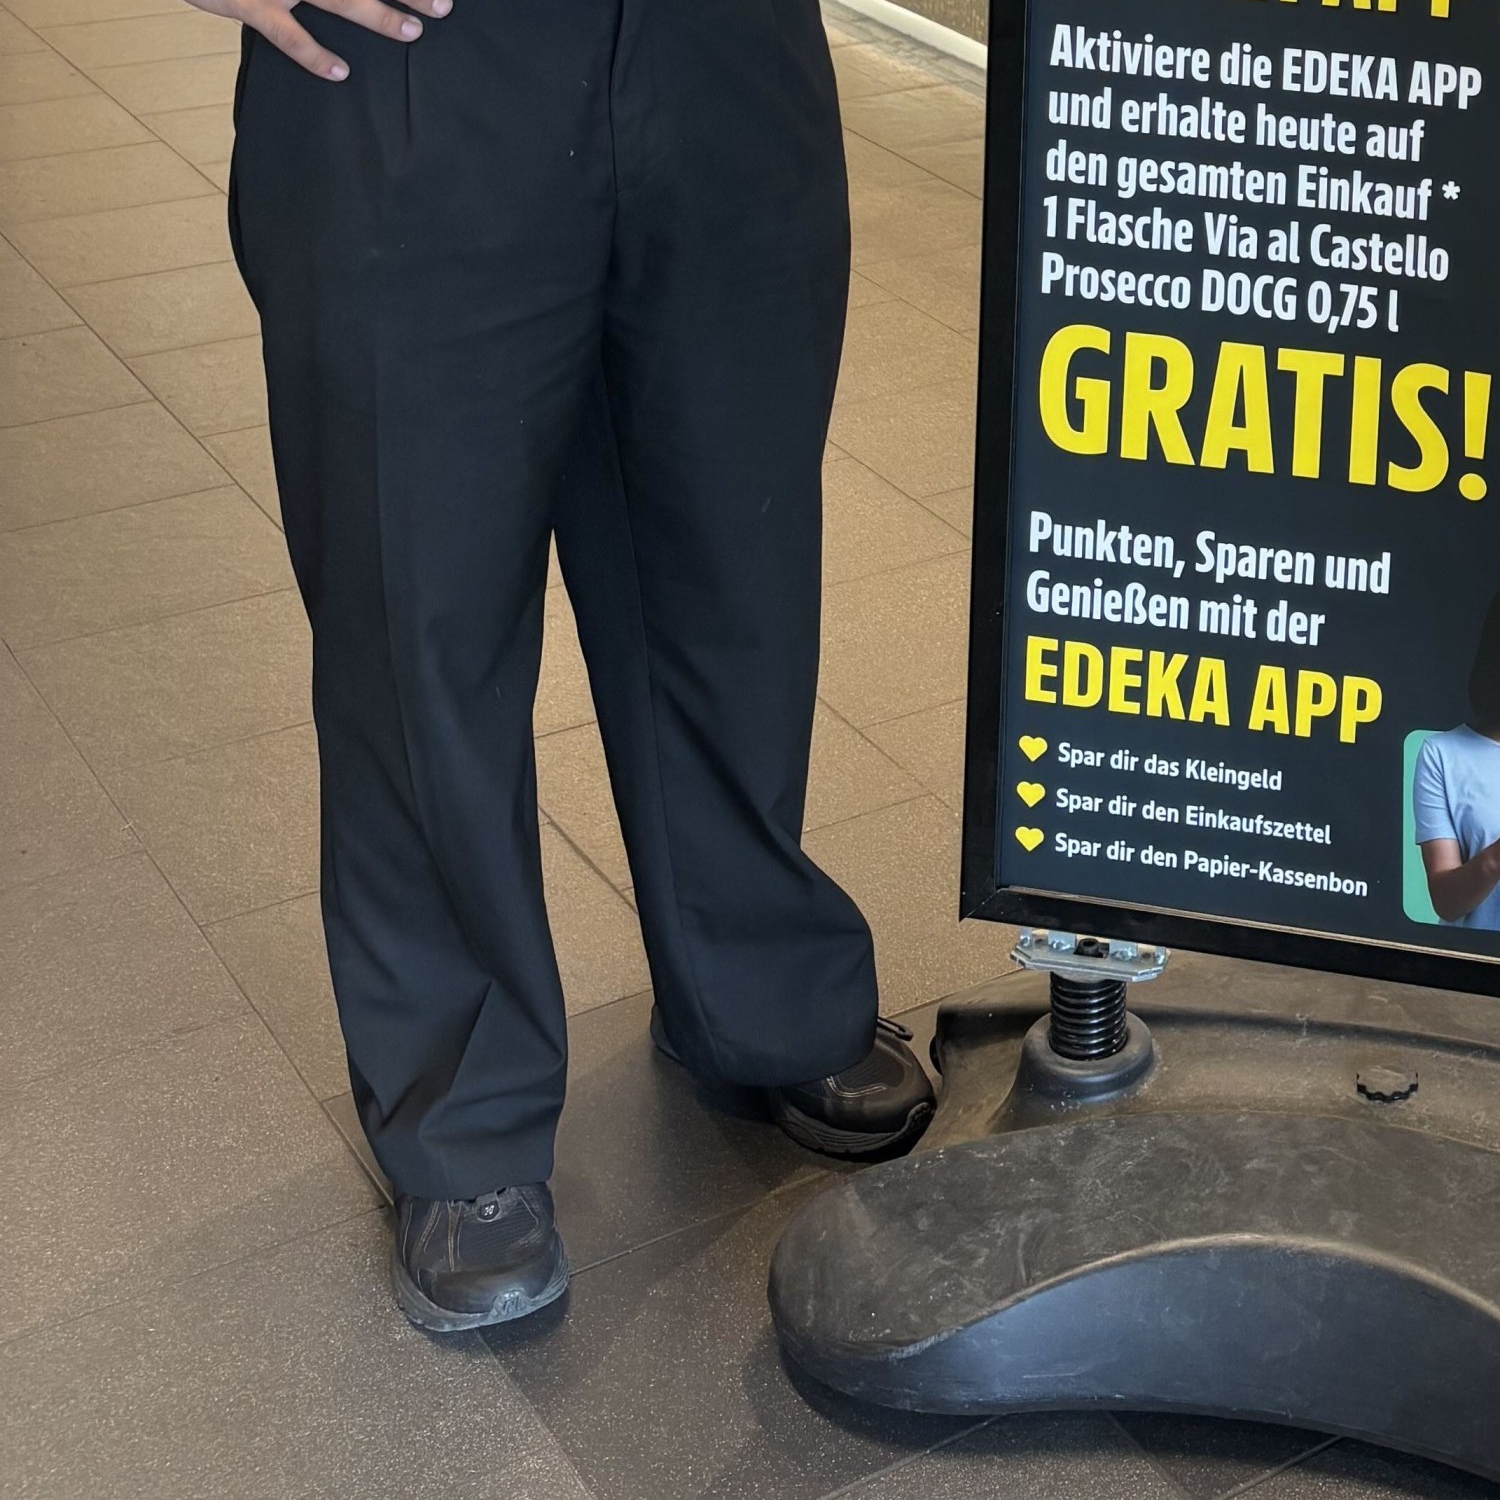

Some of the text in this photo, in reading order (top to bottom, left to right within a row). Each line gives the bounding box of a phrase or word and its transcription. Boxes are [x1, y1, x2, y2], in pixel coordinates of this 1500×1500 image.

[1050, 24, 1481, 109] Aktiviere die EDEKA APP
[1049, 87, 1425, 161] und erhalte heute auf
[1046, 139, 1107, 186] den
[1117, 157, 1286, 205] gesamten
[1297, 165, 1432, 220] Einkauf
[1044, 196, 1448, 281] 1 Flasche Via al Castello
[1042, 252, 1191, 309] Prosecco
[1202, 269, 1297, 320] DOCG
[1308, 281, 1377, 333] 0,75
[1040, 324, 1491, 500] GRATIS!
[1030, 511, 1390, 594] Punkten, Sparen und
[1027, 570, 1325, 646] Genießen mit der
[1025, 636, 1382, 743] EDEKA APP
[1058, 742, 1282, 790] Spar dir das Kleingeld
[1056, 788, 1331, 844] Spar dir den Einkaufszettel
[1055, 833, 1367, 896] Spar dir den Papier-Kassenbon
